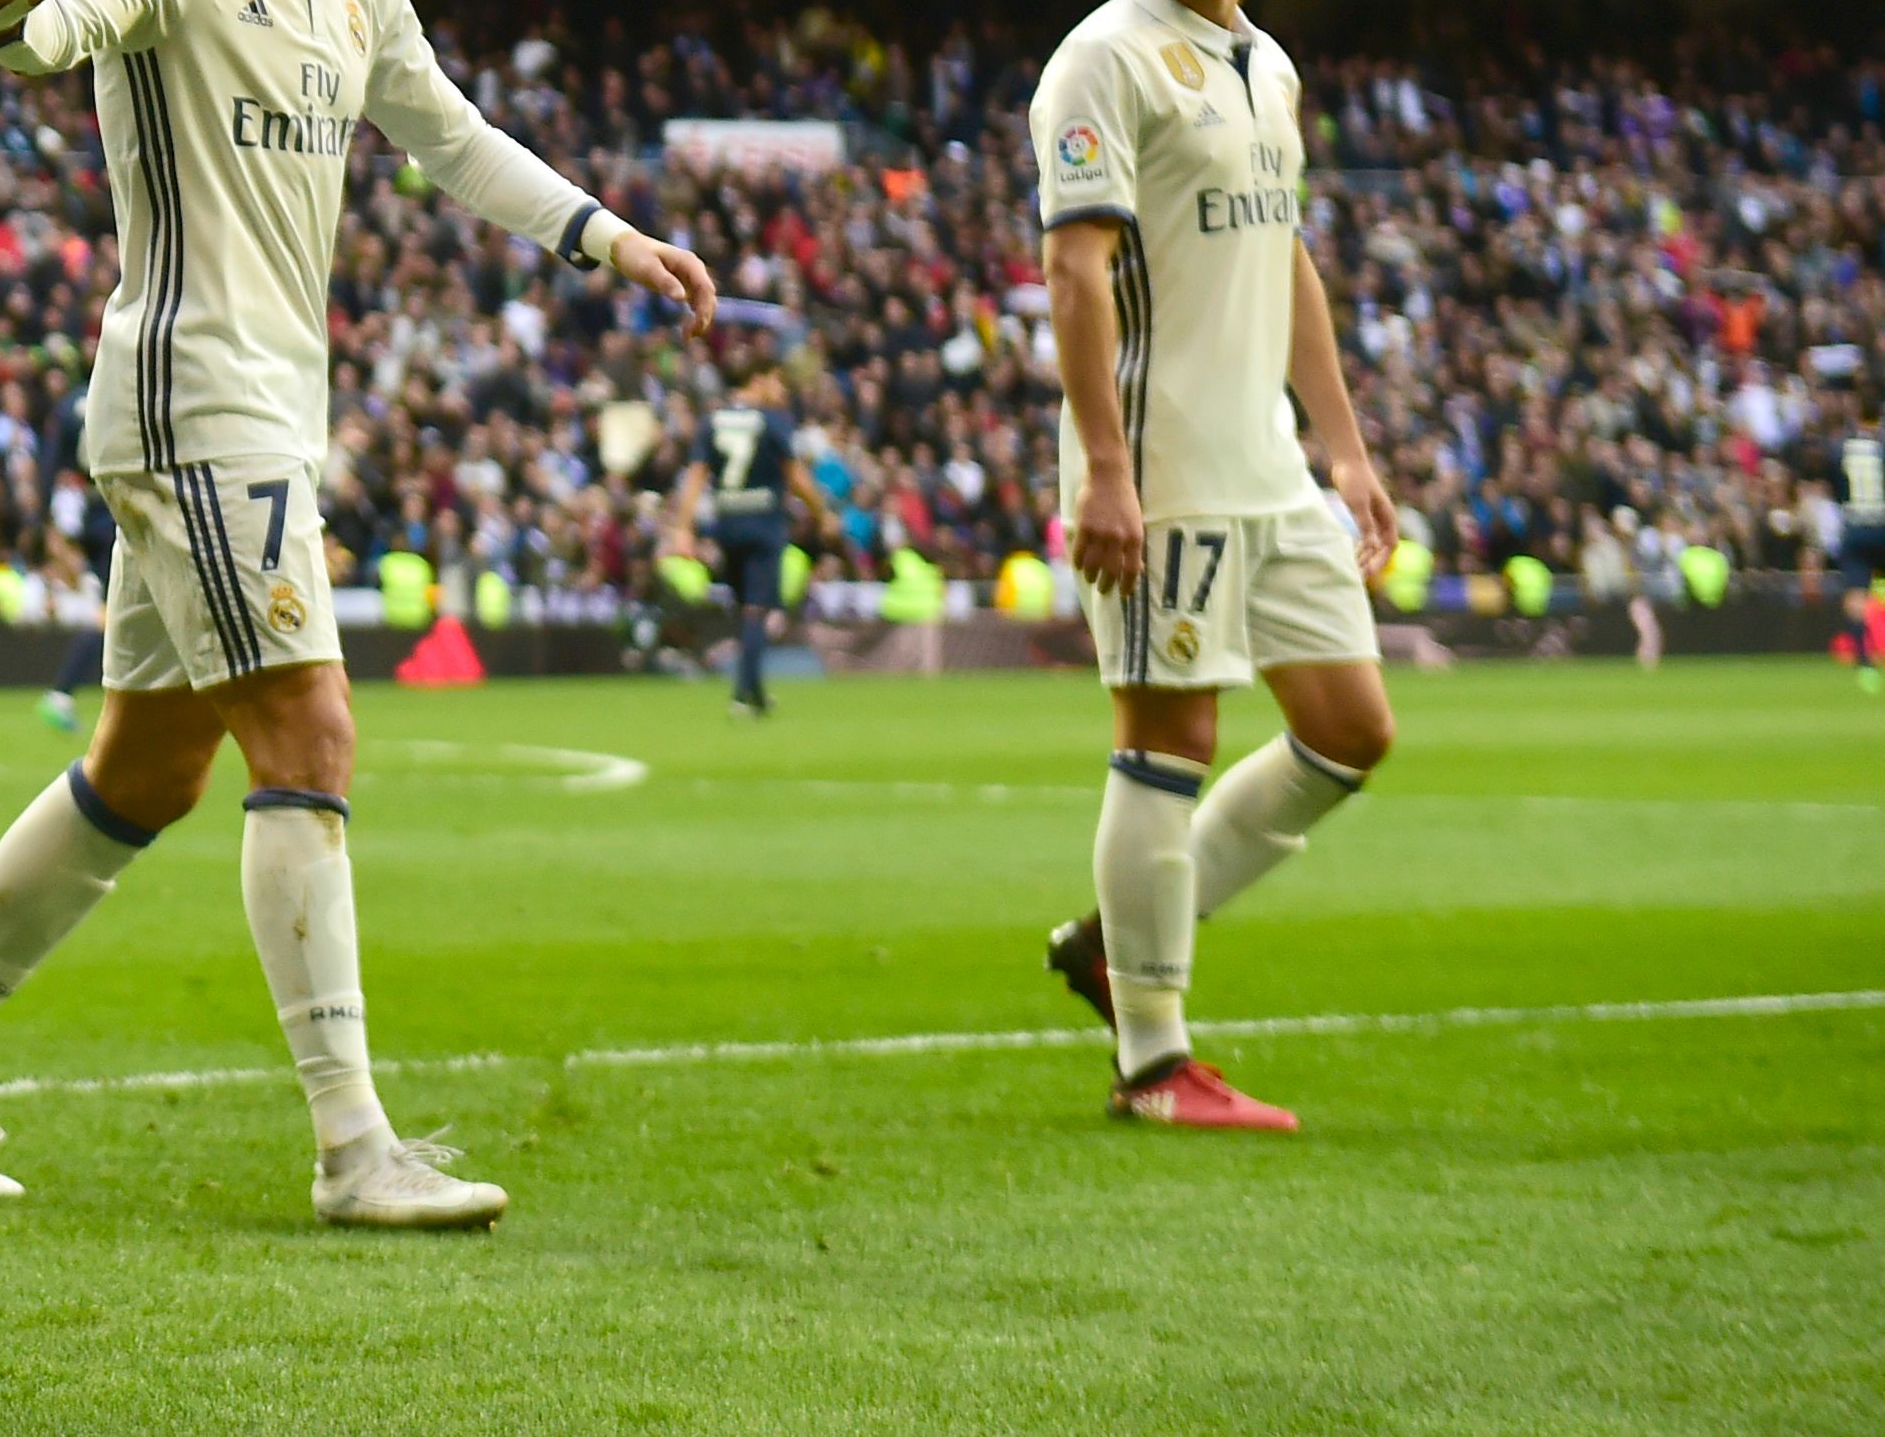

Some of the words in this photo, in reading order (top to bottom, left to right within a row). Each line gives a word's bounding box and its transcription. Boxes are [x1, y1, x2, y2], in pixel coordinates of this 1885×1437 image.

[300, 62, 341, 106] Fly
[1249, 141, 1283, 178] Fly
[246, 478, 290, 572] 7
[1162, 526, 1228, 612] 17
